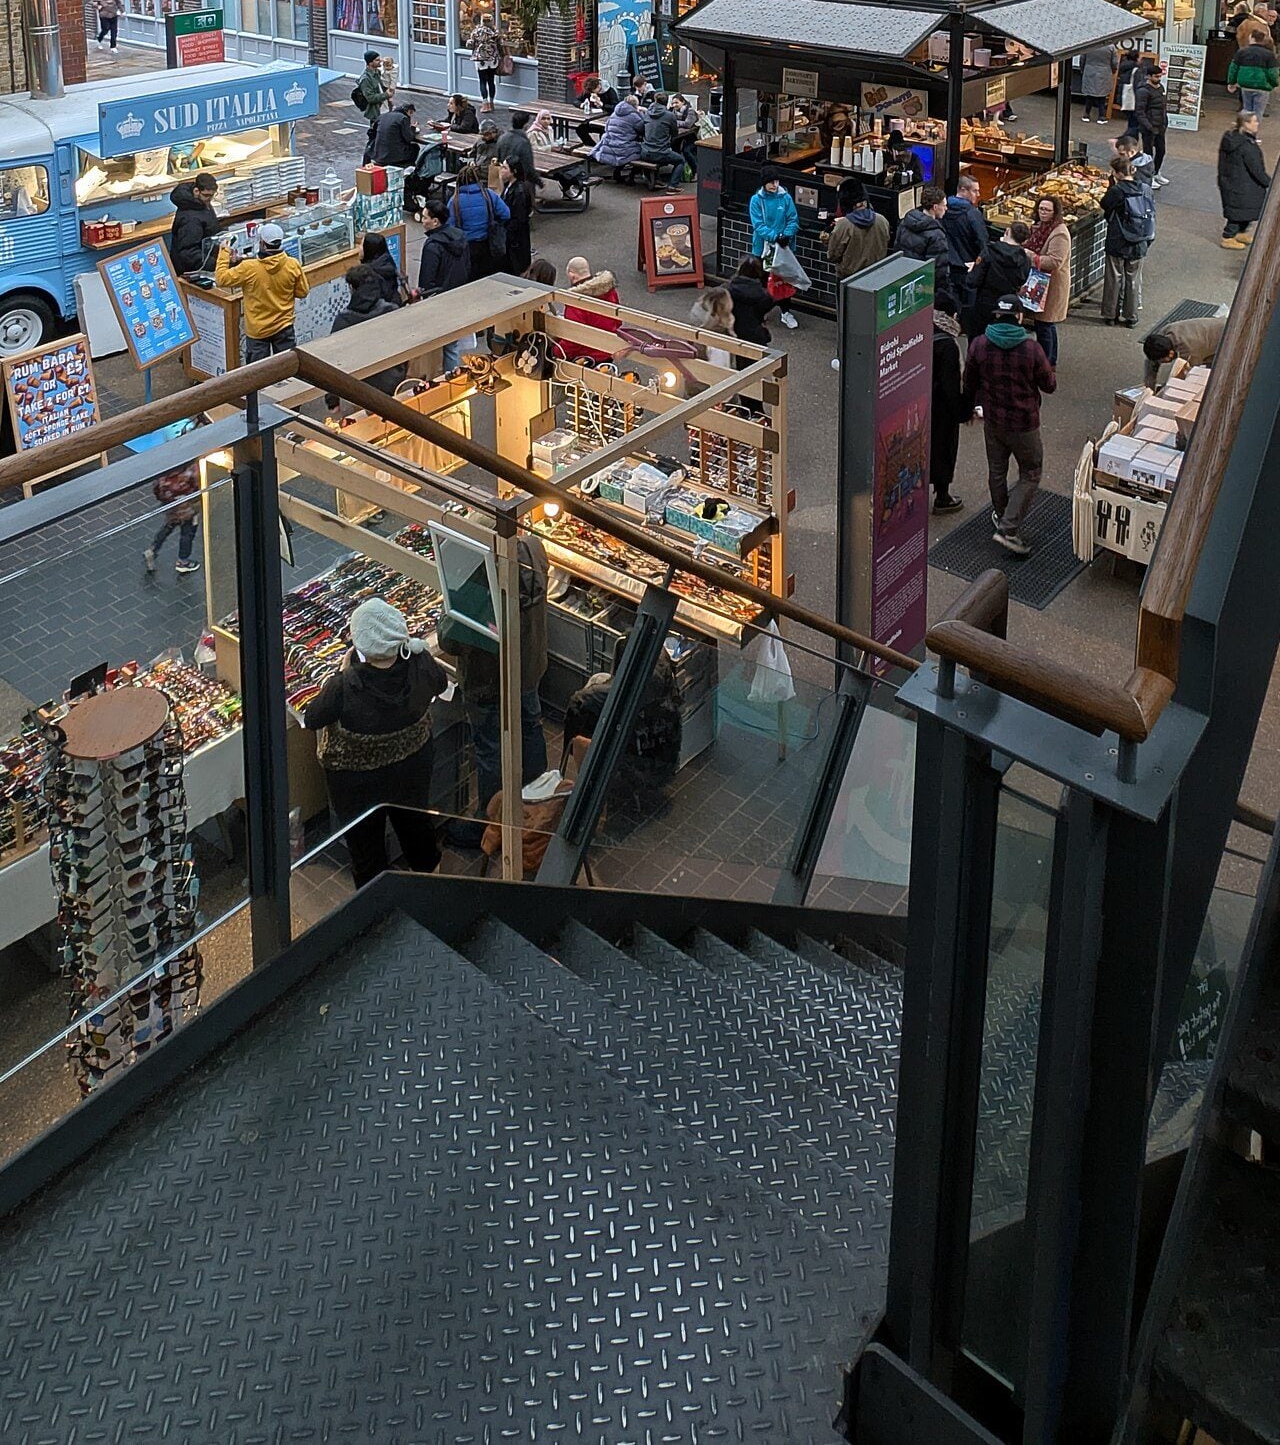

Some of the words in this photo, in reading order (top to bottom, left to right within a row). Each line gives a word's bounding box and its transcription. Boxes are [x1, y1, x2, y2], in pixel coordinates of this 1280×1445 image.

[153, 103, 199, 134] SUD
[206, 88, 278, 122] ITALIA
[206, 122, 228, 132] PIZZA
[236, 112, 278, 127] NAPOLETANA
[880, 336, 899, 354] Bidrohi
[886, 349, 896, 362] Old
[896, 333, 924, 356] Spitalfields
[14, 362, 39, 380] RUM
[42, 350, 75, 370] BABA
[66, 360, 83, 376] £5
[879, 360, 898, 378] Market
[43, 380, 57, 392] OR
[18, 399, 44, 417] TAKE
[46, 398, 53, 406] 2
[56, 390, 75, 404] FOR
[78, 384, 90, 396] £7
[24, 428, 42, 441] SOFT
[43, 418, 69, 434] SPONGE
[71, 410, 89, 423] CAKE
[42, 408, 70, 424] ITALIAN
[34, 434, 60, 447] SOAKED
[62, 429, 70, 437] IN
[71, 422, 86, 432] RUM
